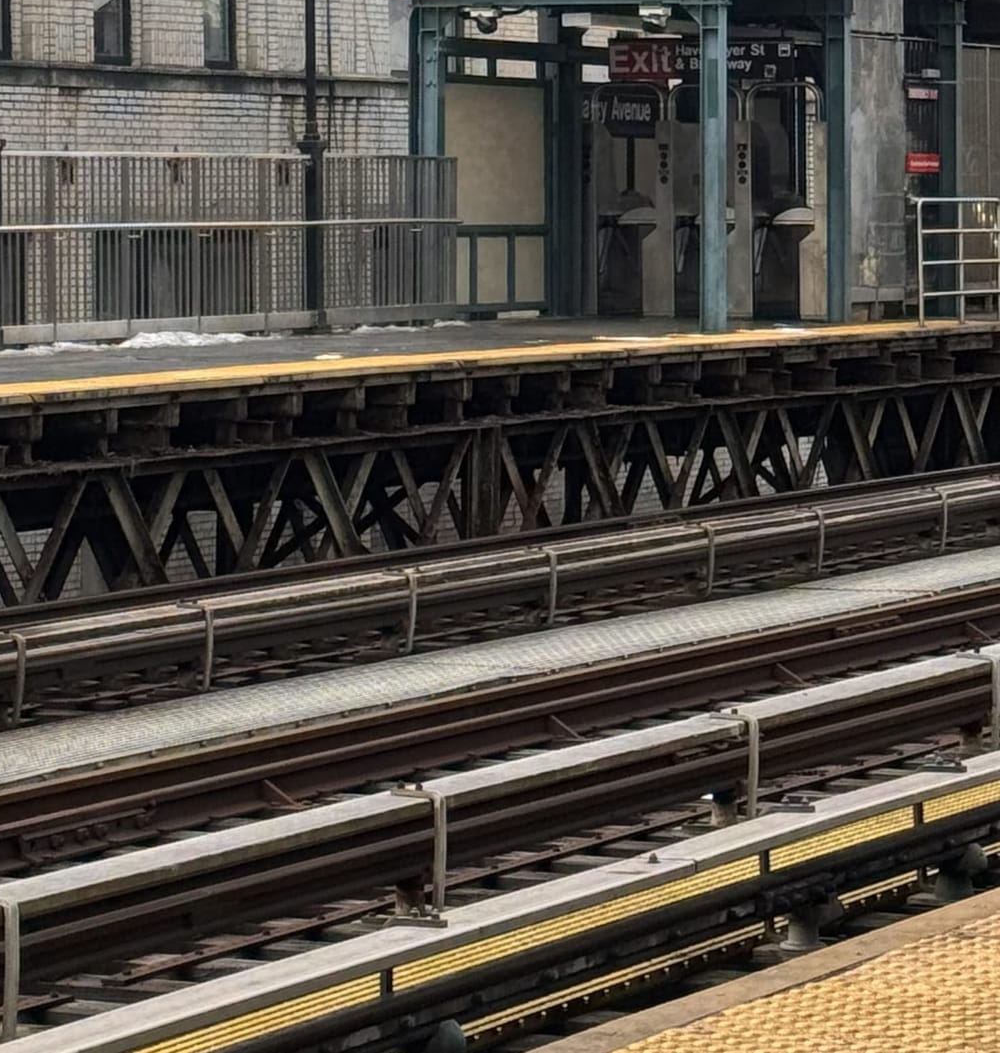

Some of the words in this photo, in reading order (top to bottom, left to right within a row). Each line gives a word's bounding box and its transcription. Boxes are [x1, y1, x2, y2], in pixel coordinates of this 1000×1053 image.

[609, 44, 673, 74] Exit
[675, 44, 746, 58] Havyer
[750, 43, 765, 56] St
[675, 57, 685, 70] &
[611, 96, 651, 122] Avenue
